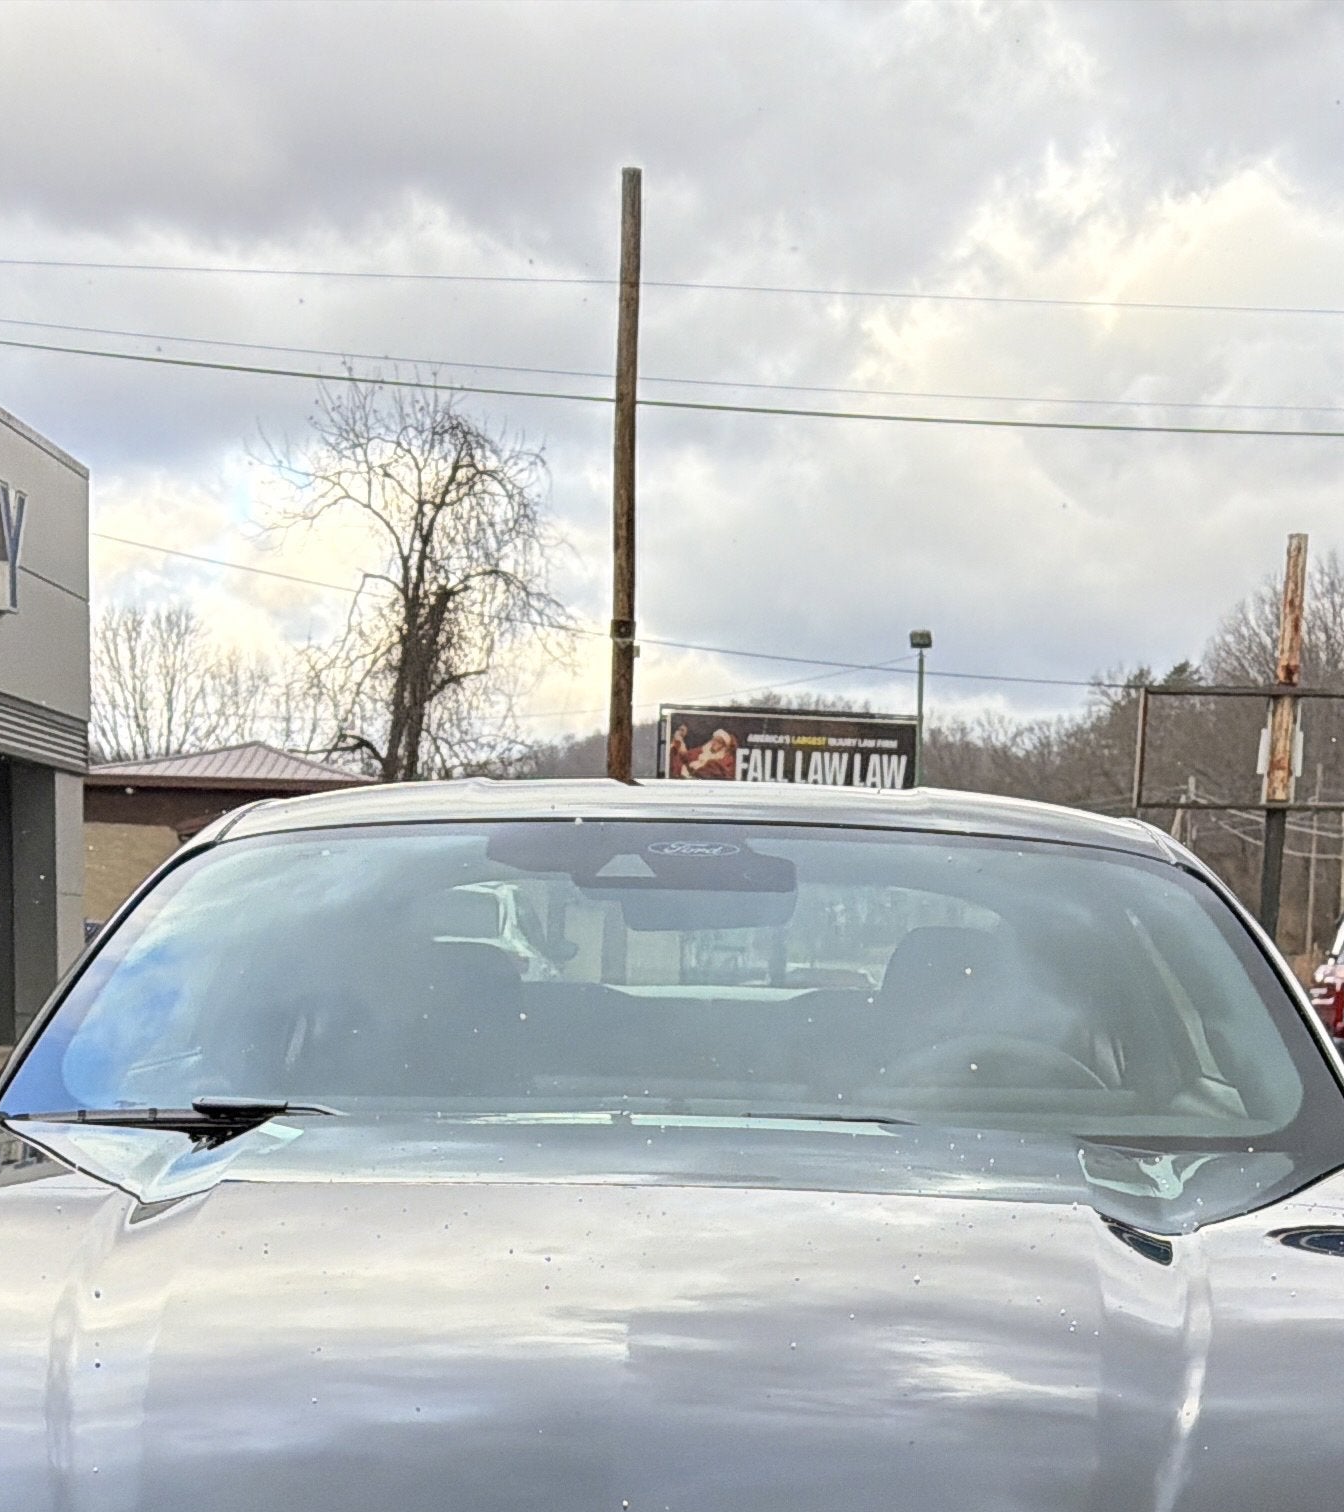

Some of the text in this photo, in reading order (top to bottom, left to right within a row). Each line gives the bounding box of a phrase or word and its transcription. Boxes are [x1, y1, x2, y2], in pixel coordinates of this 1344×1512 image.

[736, 748, 908, 789] FALL LAW LAW
[664, 842, 723, 856] Ford
